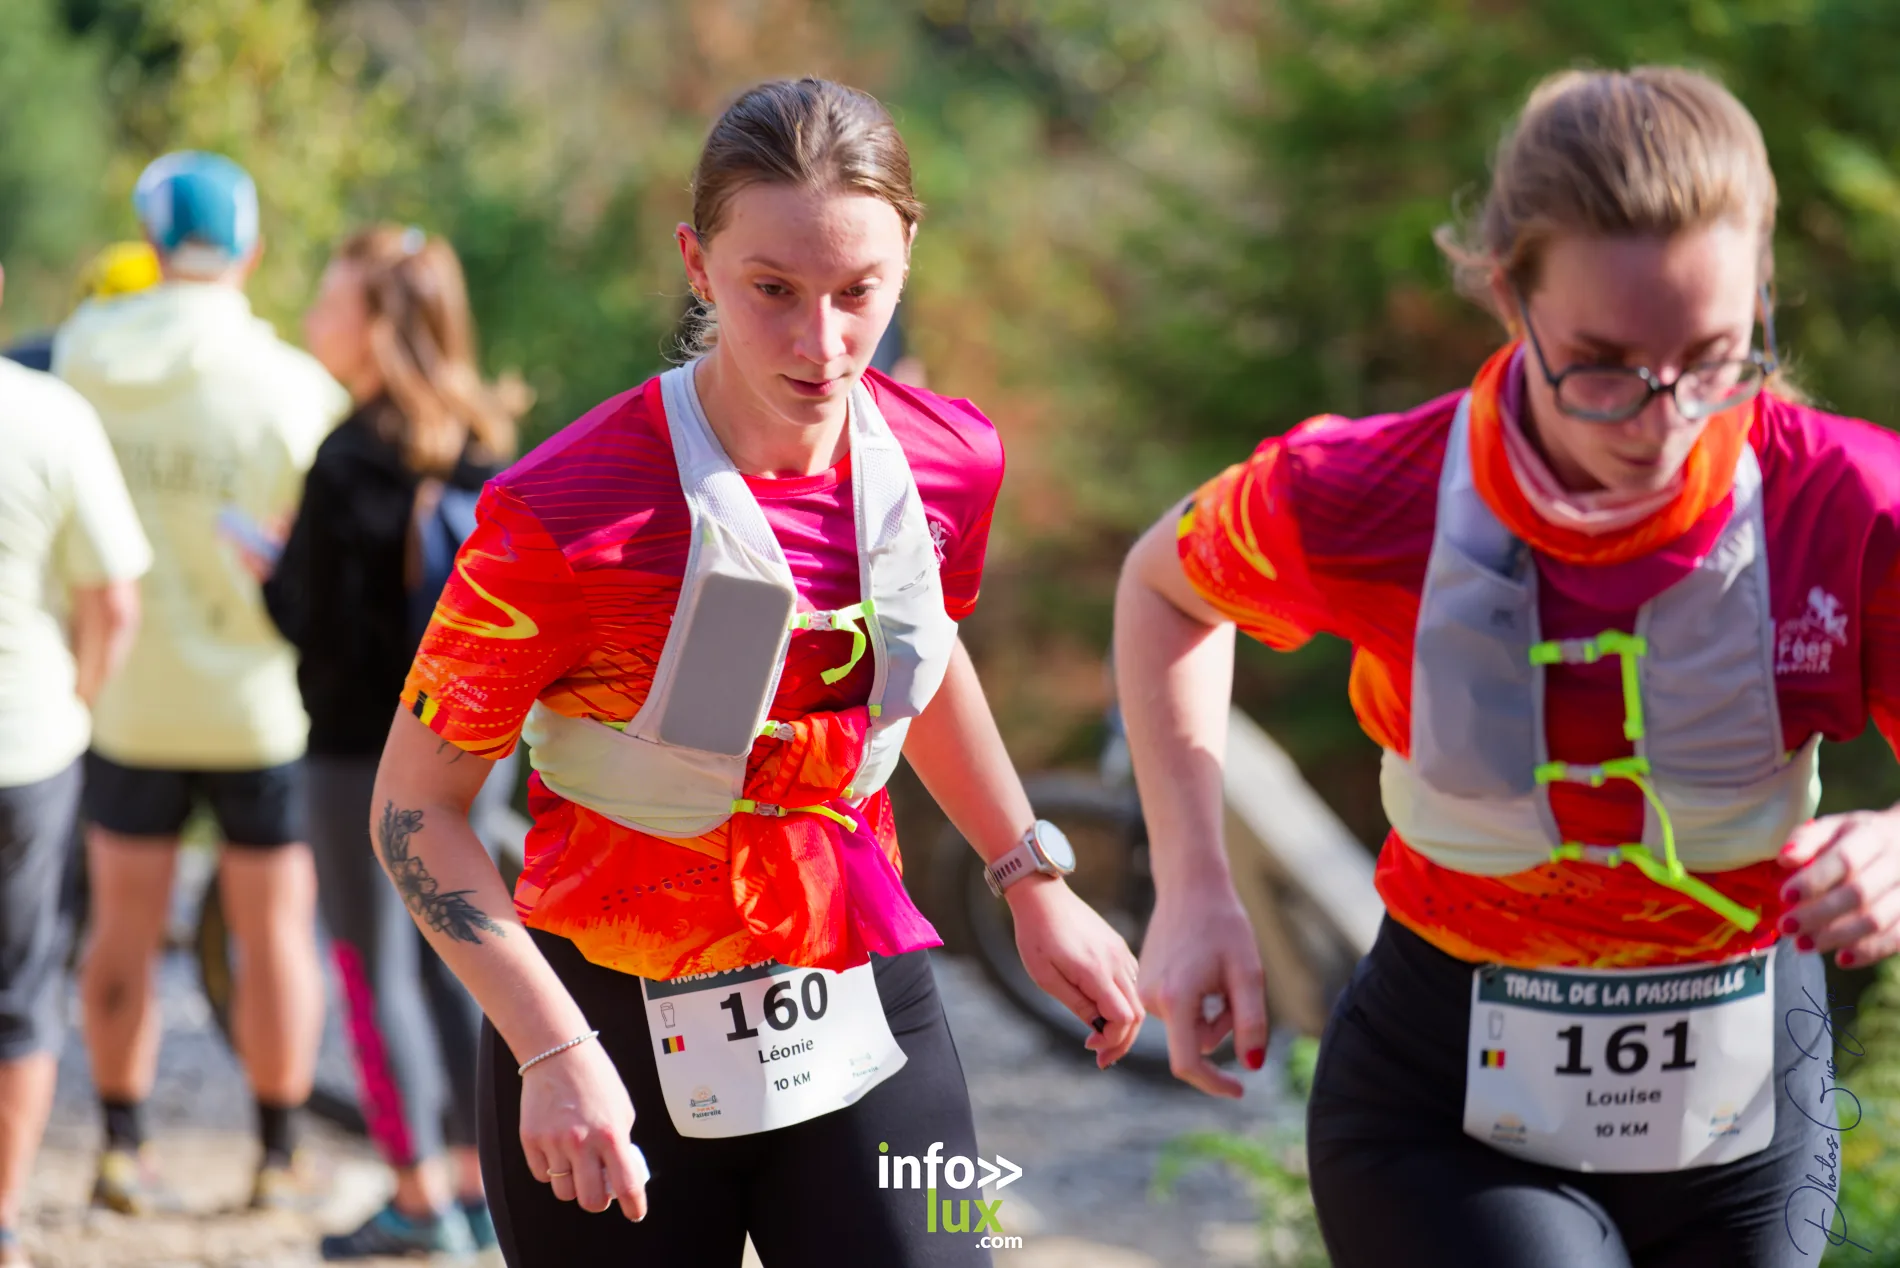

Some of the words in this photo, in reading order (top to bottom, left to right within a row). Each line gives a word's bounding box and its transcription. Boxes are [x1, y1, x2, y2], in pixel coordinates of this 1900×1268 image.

[1504, 974, 1563, 1001] TRAIL
[1569, 982, 1597, 1005] DE
[1602, 984, 1630, 1006] LA
[1636, 967, 1746, 1005] PASSERELLE
[720, 972, 828, 1042] 160
[758, 1039, 814, 1064] Léonie
[1555, 1020, 1697, 1076] 161
[774, 1078, 789, 1091] 10
[793, 1071, 811, 1086] KM
[1586, 1089, 1662, 1107] Louise
[1595, 1123, 1613, 1138] 10
[1620, 1121, 1649, 1137] KM
